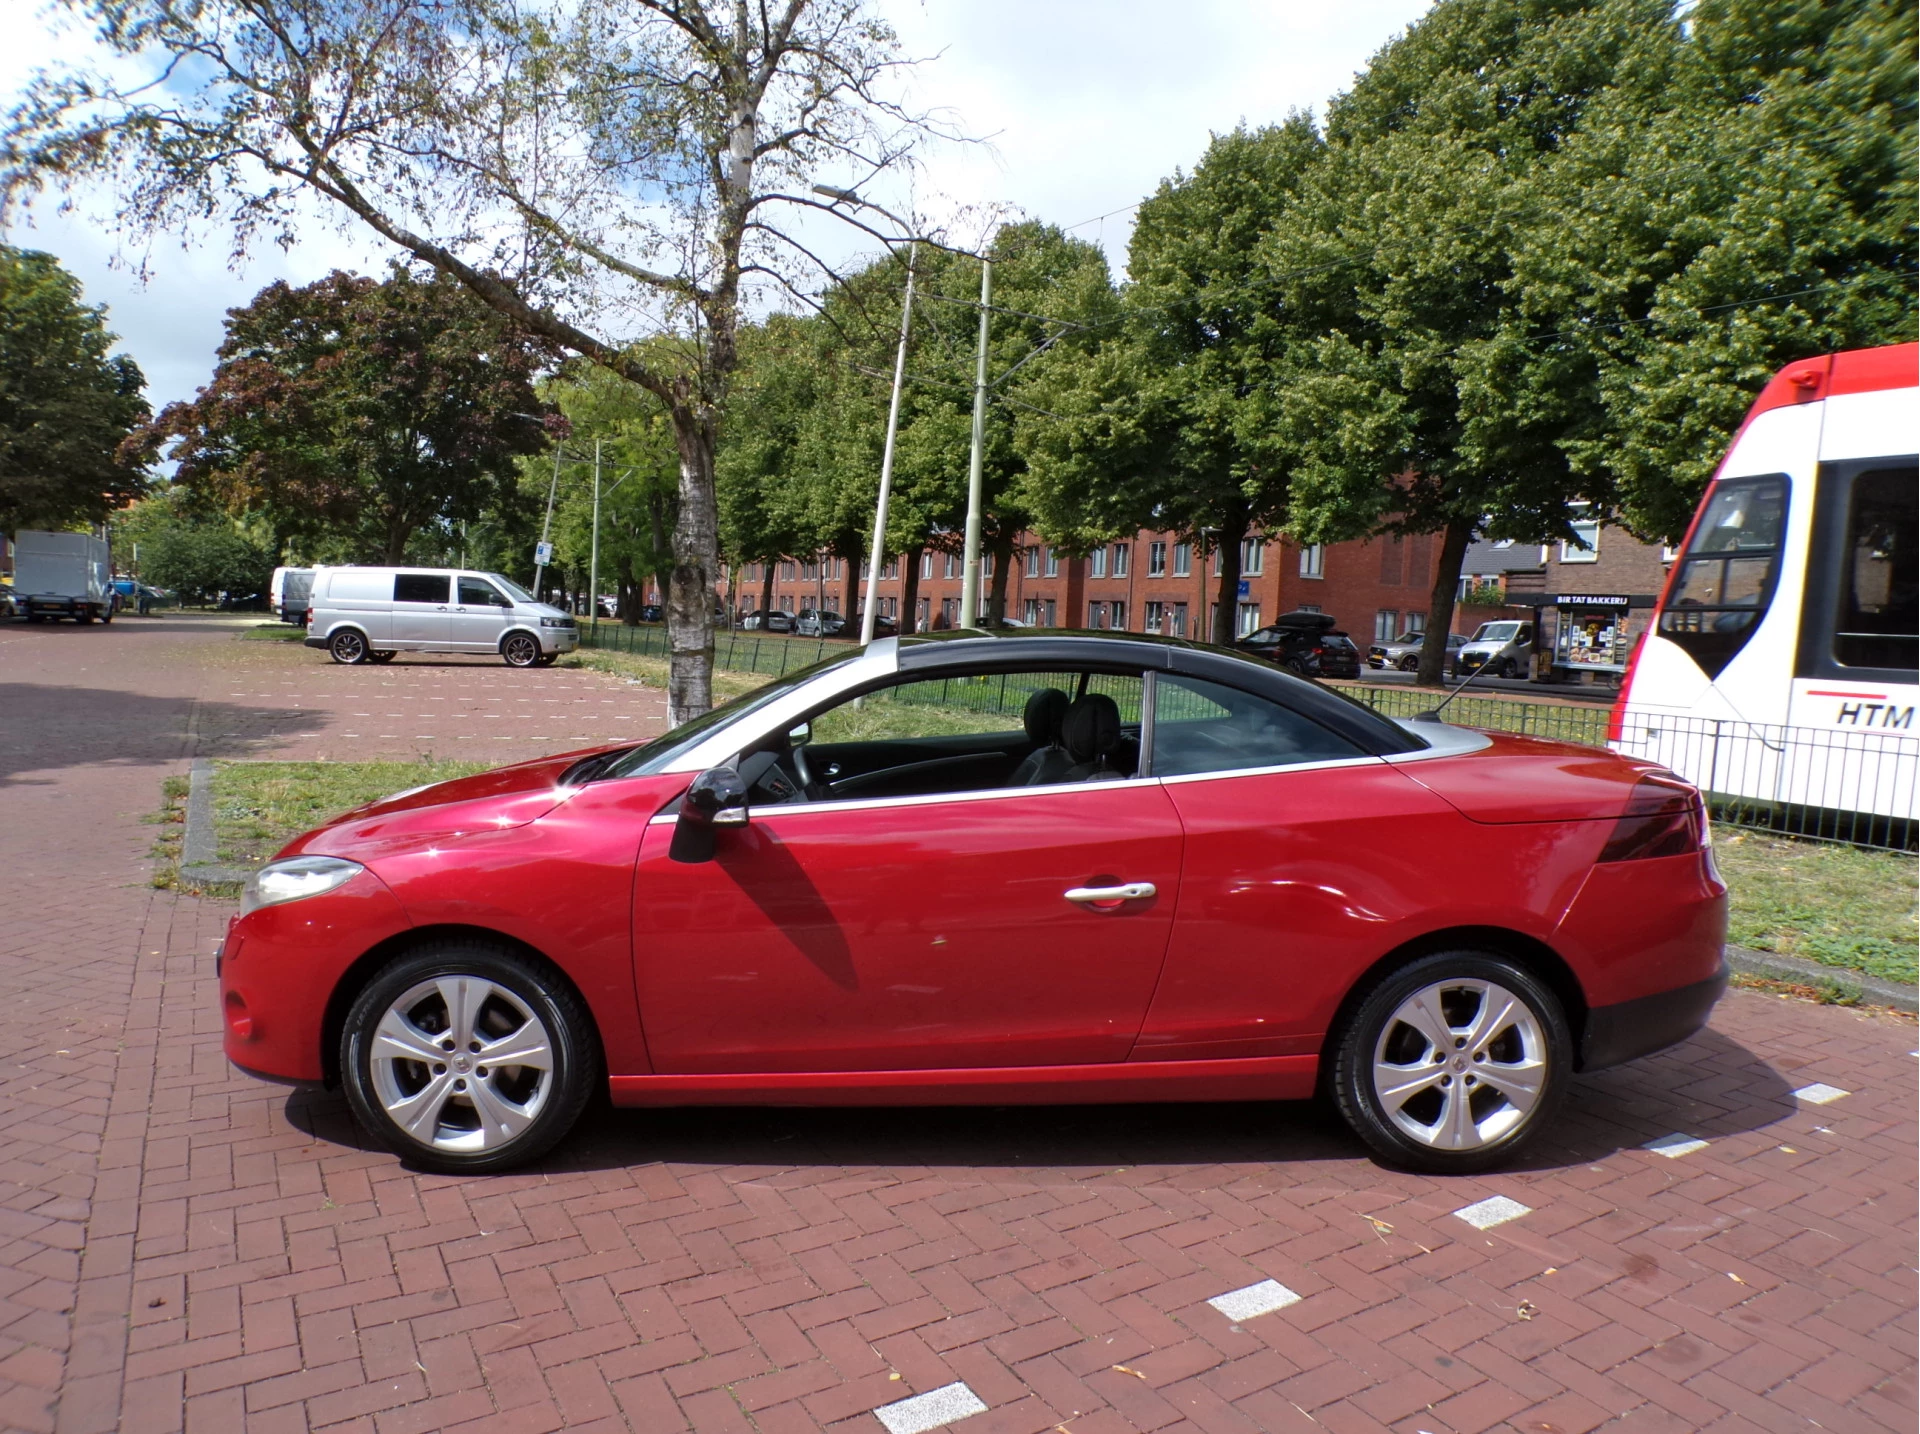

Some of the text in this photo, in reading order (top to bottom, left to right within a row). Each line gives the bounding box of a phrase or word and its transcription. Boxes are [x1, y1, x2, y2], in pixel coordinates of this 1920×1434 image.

[1557, 596, 1628, 605] BIR TAT BAKKERIJ
[1836, 702, 1915, 729] HTM
